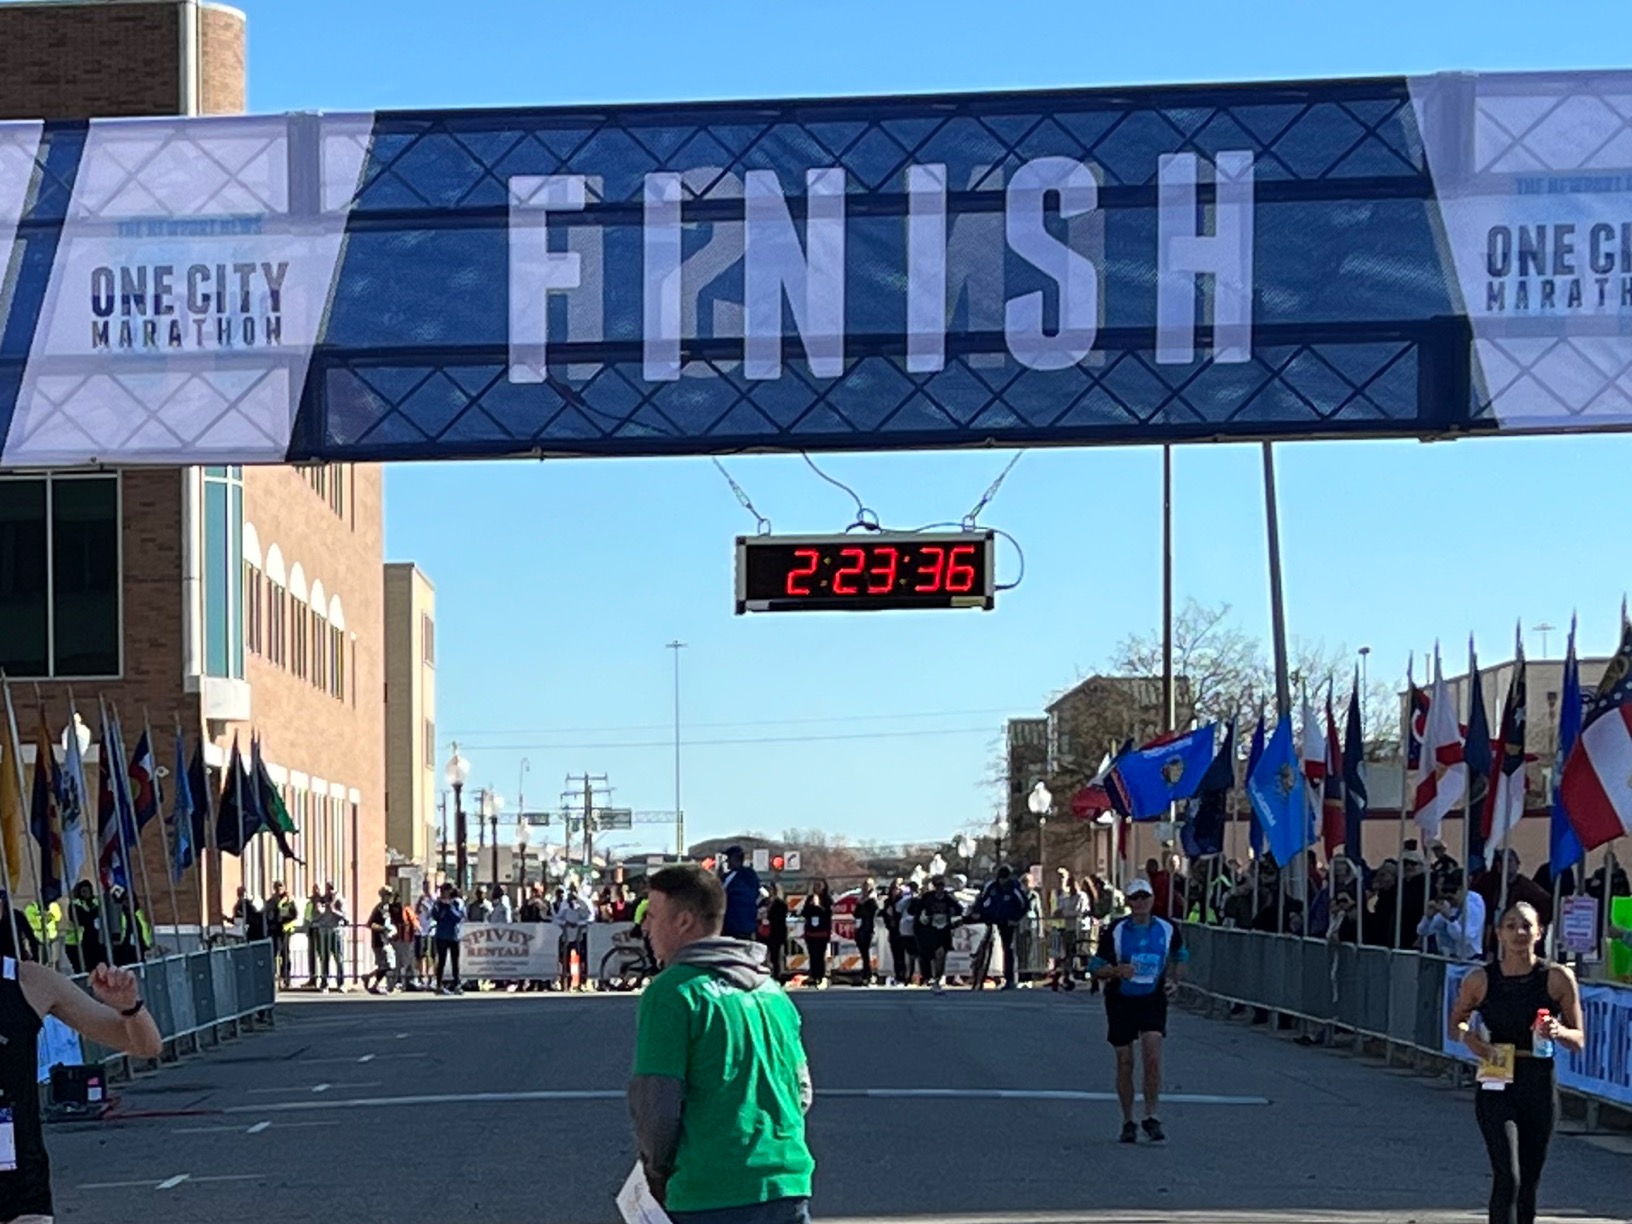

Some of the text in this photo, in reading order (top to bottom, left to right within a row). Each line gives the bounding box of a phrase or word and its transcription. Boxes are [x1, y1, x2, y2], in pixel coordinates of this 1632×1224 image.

[508, 150, 1256, 385] FINISH
[1486, 222, 1576, 278] ONE
[91, 261, 289, 318] ONE CITY
[91, 317, 282, 349] MARATHON
[783, 547, 976, 595] 2:23:36
